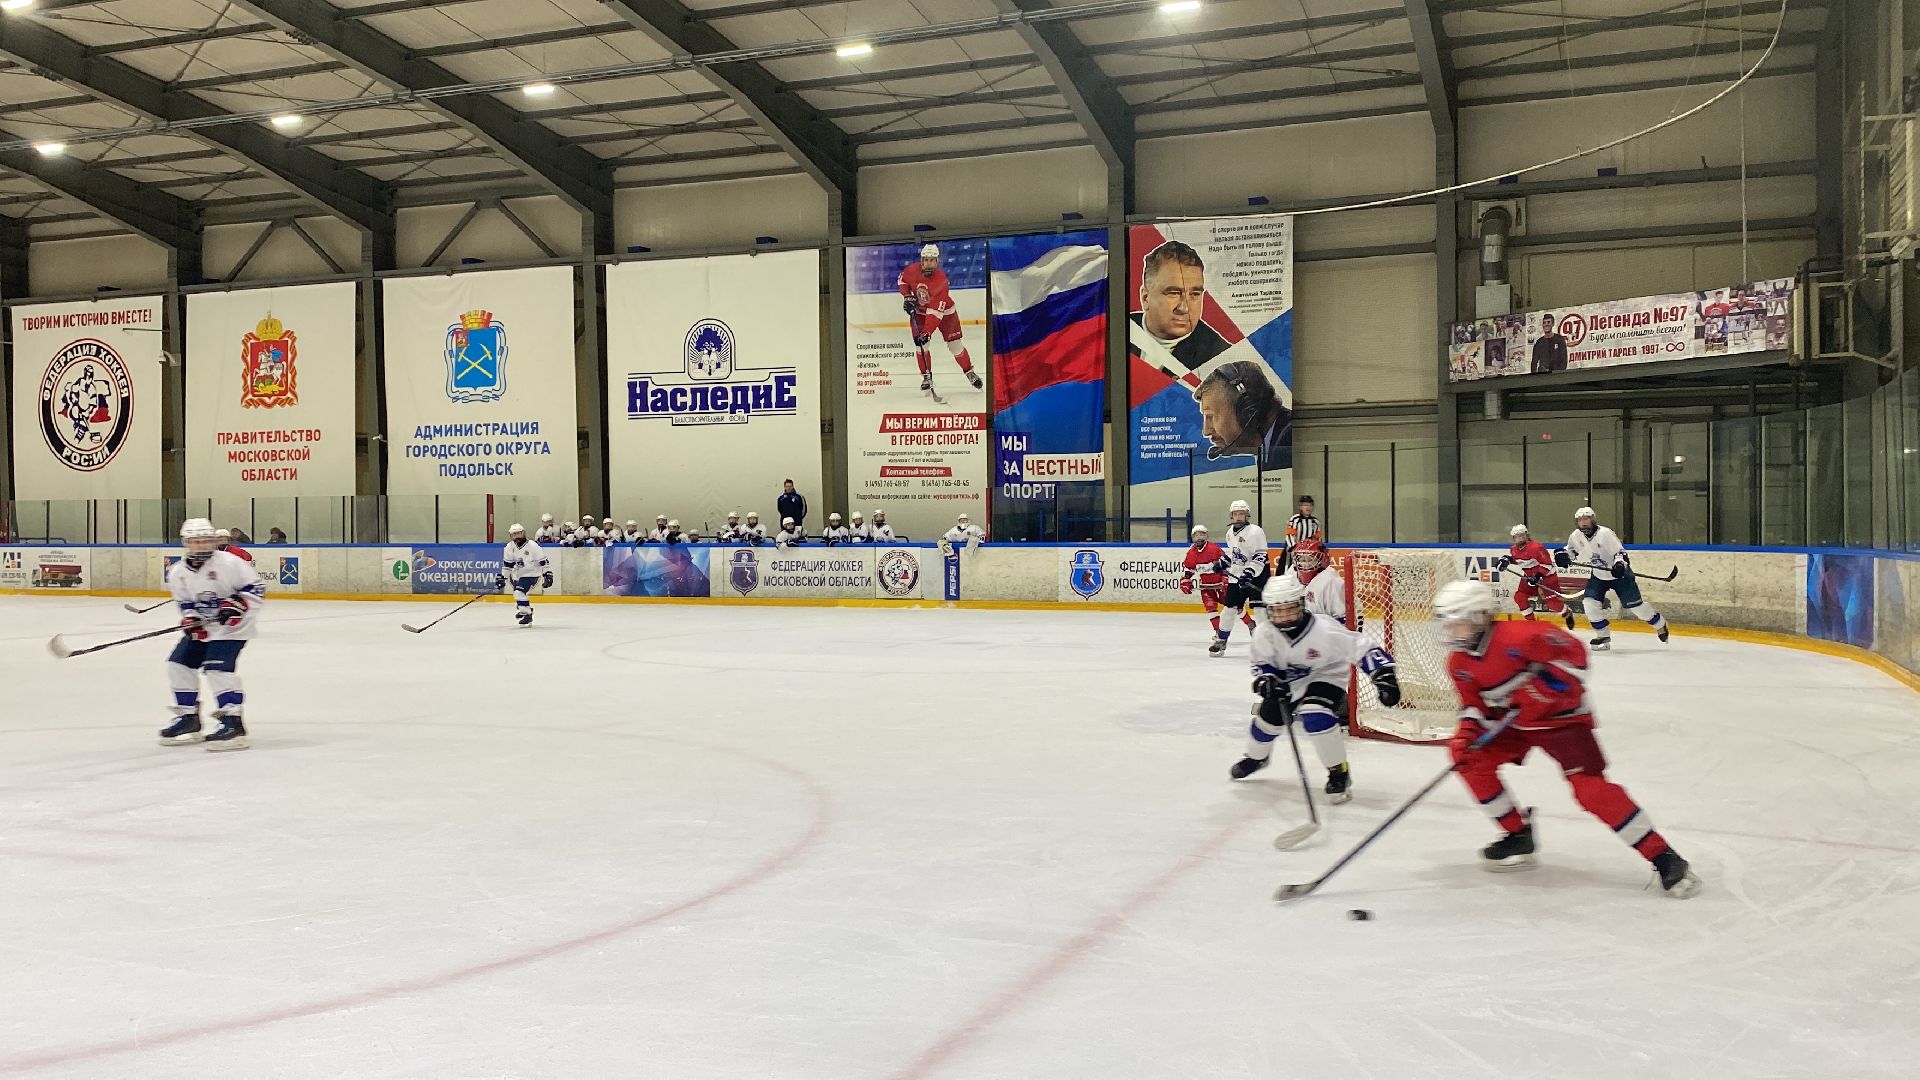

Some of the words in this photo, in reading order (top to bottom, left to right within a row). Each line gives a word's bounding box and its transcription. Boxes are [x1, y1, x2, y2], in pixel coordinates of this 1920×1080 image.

[22, 315, 61, 331] ТВОРИМ
[62, 311, 109, 328] ИСТОРИЮ
[111, 309, 152, 325] ВМЕСТЕ!
[1589, 311, 1651, 331] Легенда
[1653, 305, 1688, 324] №97
[1568, 349, 1607, 363] ДМИТРИЙ
[43, 344, 97, 401] ФЕДЕРАЦИЯ
[98, 347, 129, 398] ХОККЕЯ
[627, 374, 797, 415] НаследиЕ
[414, 420, 540, 441] АДМИНИСТРАЦИЯ
[885, 417, 904, 430] МЫ
[905, 417, 938, 430] ВЕРИМ
[939, 415, 979, 430] ТВЁРДО
[217, 429, 321, 446] ПРАВИТЕЛЬСТВО
[890, 435, 897, 446] В
[899, 435, 934, 446] ГЕРОЕВ
[936, 433, 979, 445] СПОРТА!
[1001, 436, 1027, 452] МЫ
[228, 445, 311, 463] МОСКОВСКОЙ
[405, 441, 493, 461] ГОРОДСКОГО
[495, 439, 551, 456] ОКРУГА
[438, 461, 514, 478] ПОДОЛЬСК
[1003, 460, 1021, 476] ЗА
[1025, 453, 1102, 477] ЧЕСТНЫЙ
[241, 467, 298, 482] ОБЛАСТИ
[1003, 482, 1056, 499] СПОРТ!
[438, 560, 473, 571] крокус
[475, 560, 500, 569] сити
[770, 560, 826, 573] ФЕДЕРАЦИЯ
[828, 560, 864, 572] ХОККЕЯ
[1119, 561, 1186, 574] ФЕДЕРАЦИЯ
[419, 571, 498, 587] океанариум
[763, 574, 826, 588] МОСКОВСКОЙ
[828, 575, 872, 587] ОБЛАСТИ
[1113, 577, 1181, 590] МОСКОВСКО
